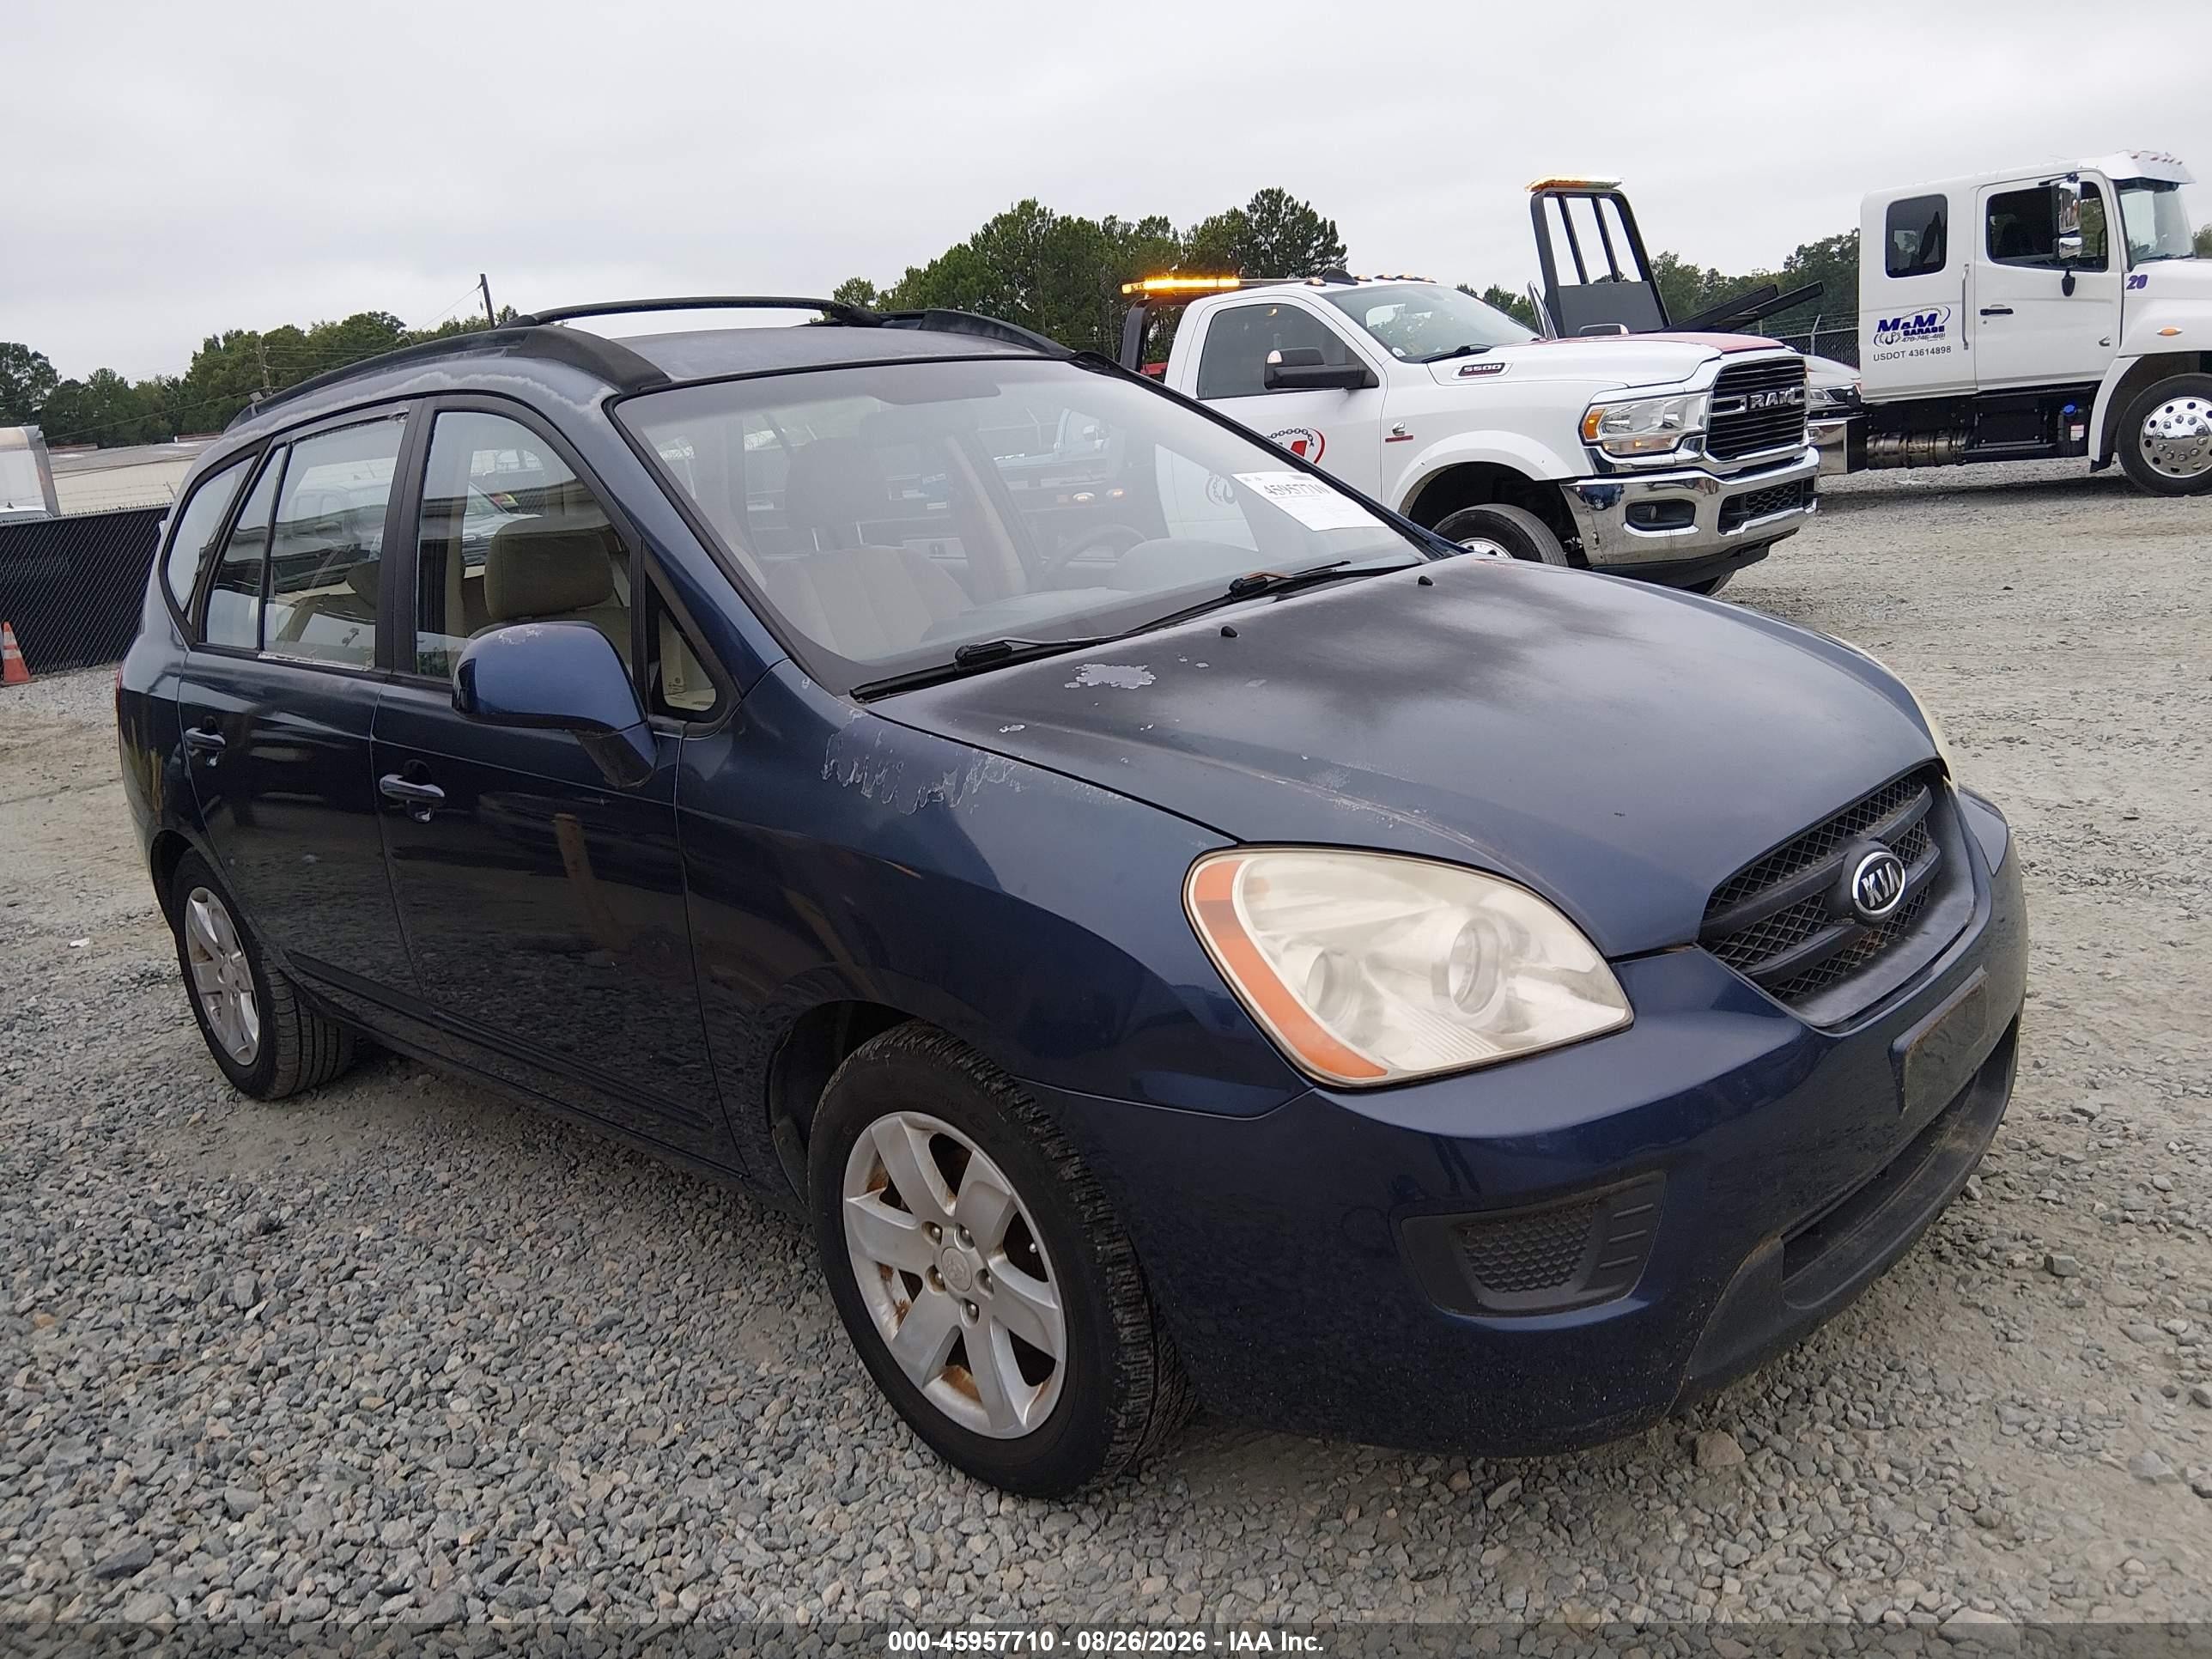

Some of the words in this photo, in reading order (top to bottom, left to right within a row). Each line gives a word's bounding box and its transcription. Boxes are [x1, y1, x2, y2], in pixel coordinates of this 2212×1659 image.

[2126, 274, 2148, 290] 20
[1903, 325, 1945, 337] GARAGE
[1873, 350, 1906, 362] USDOT
[1908, 345, 1952, 357] 43614898
[1463, 364, 1502, 373] 5500
[1749, 390, 1795, 410] RAM
[1860, 861, 1901, 908] KIA
